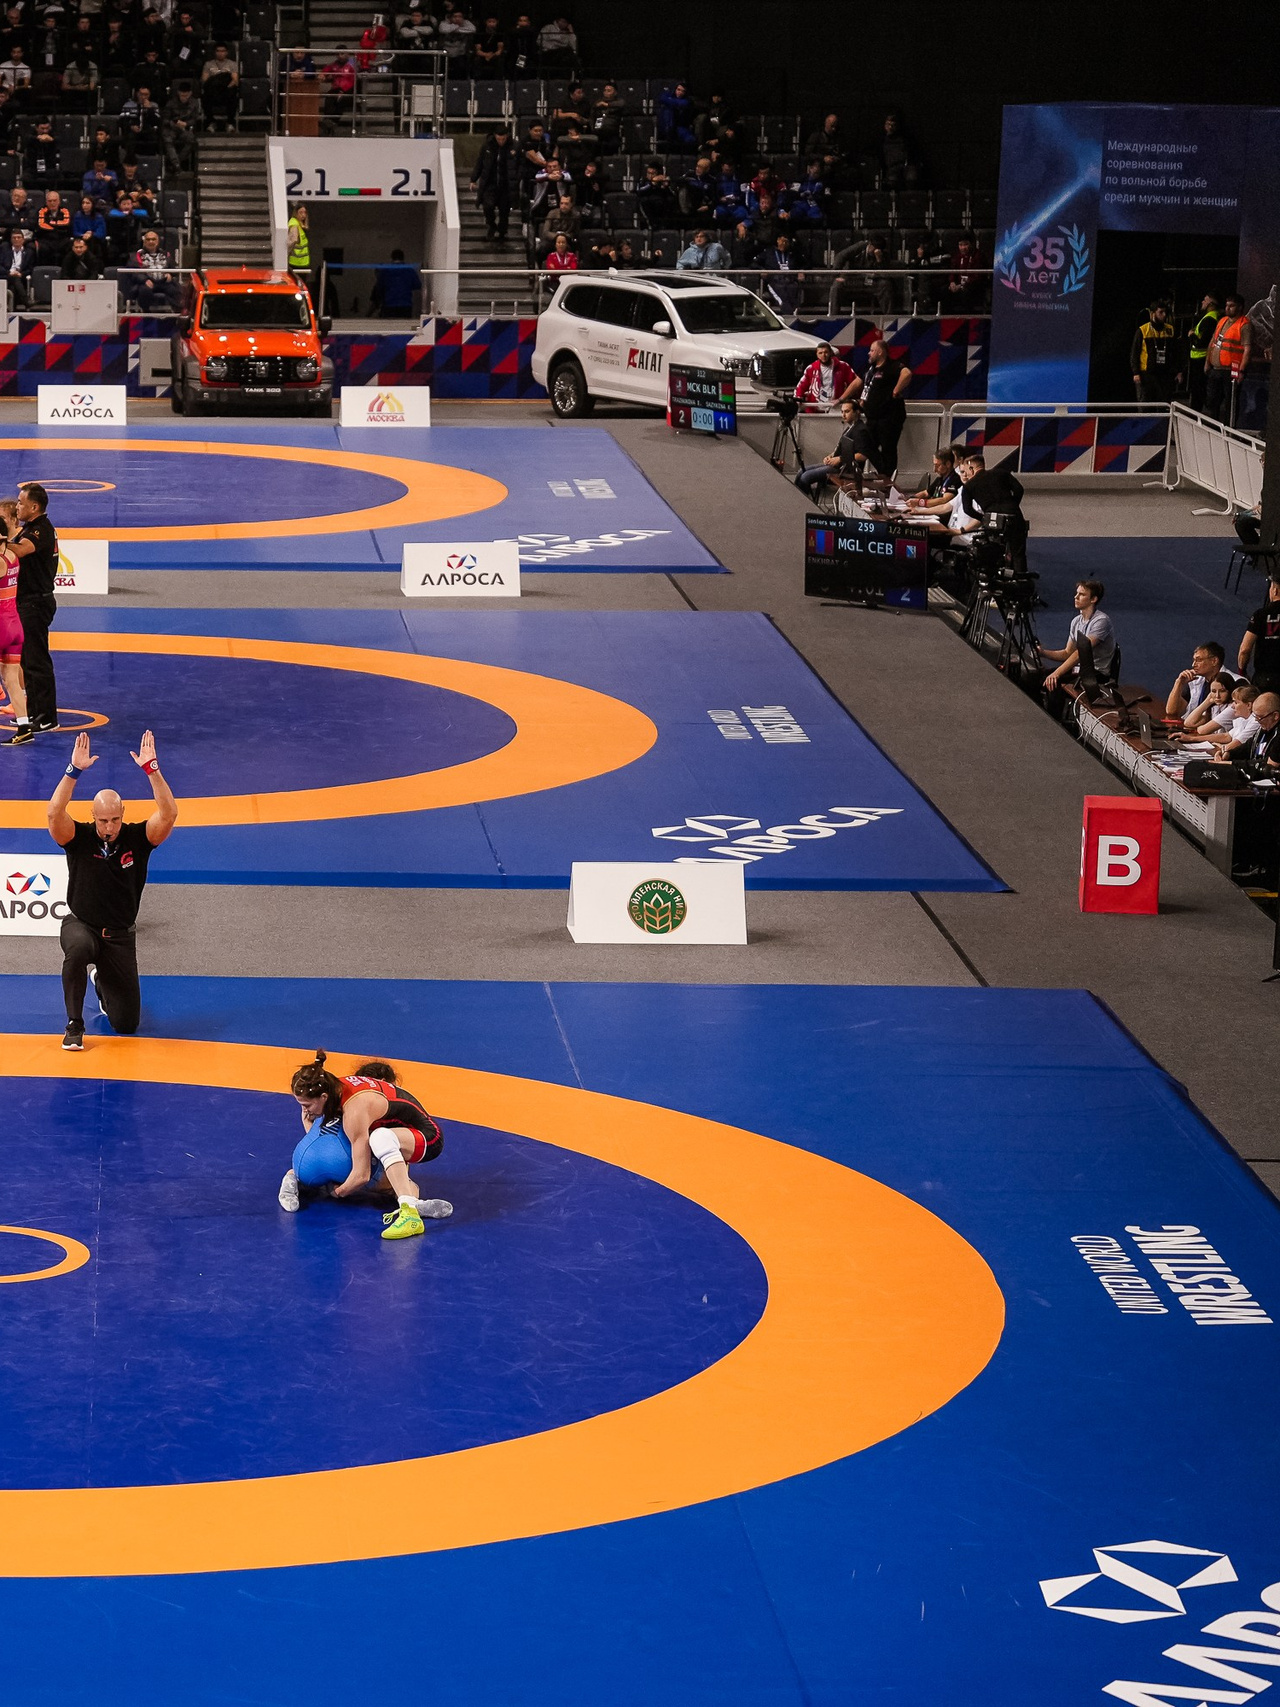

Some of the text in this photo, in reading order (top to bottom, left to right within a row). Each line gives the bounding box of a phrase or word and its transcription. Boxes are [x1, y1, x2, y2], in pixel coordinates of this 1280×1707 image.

[1107, 140, 1198, 154] Международные
[1106, 159, 1183, 172] соревнования
[285, 168, 329, 196] 2.1
[391, 168, 436, 196] 2.1
[1105, 174, 1208, 190] по вольной борьбе
[1104, 192, 1238, 208] среди мужчин и женщин
[1023, 236, 1066, 270] 35
[638, 350, 664, 373] АГАТ
[702, 384, 717, 395] BLR
[50, 408, 114, 418] АЛРОСА
[679, 410, 685, 423] 2
[692, 411, 713, 425] 0:00
[719, 416, 729, 429] 11
[858, 522, 875, 532] 259
[888, 526, 926, 537] 1/2 Final
[838, 538, 864, 552] MGL
[867, 541, 893, 555] CEB
[54, 577, 75, 587] КВА
[421, 573, 505, 586] АЛРОСА
[673, 806, 904, 865] ЛРОСА
[1096, 835, 1142, 886] B
[631, 882, 684, 921] СТОЙЛЕНСКАЯ НИВА
[1070, 1235, 1169, 1315] UNITED WORLD
[1124, 1225, 1274, 1326] WRESTLING
